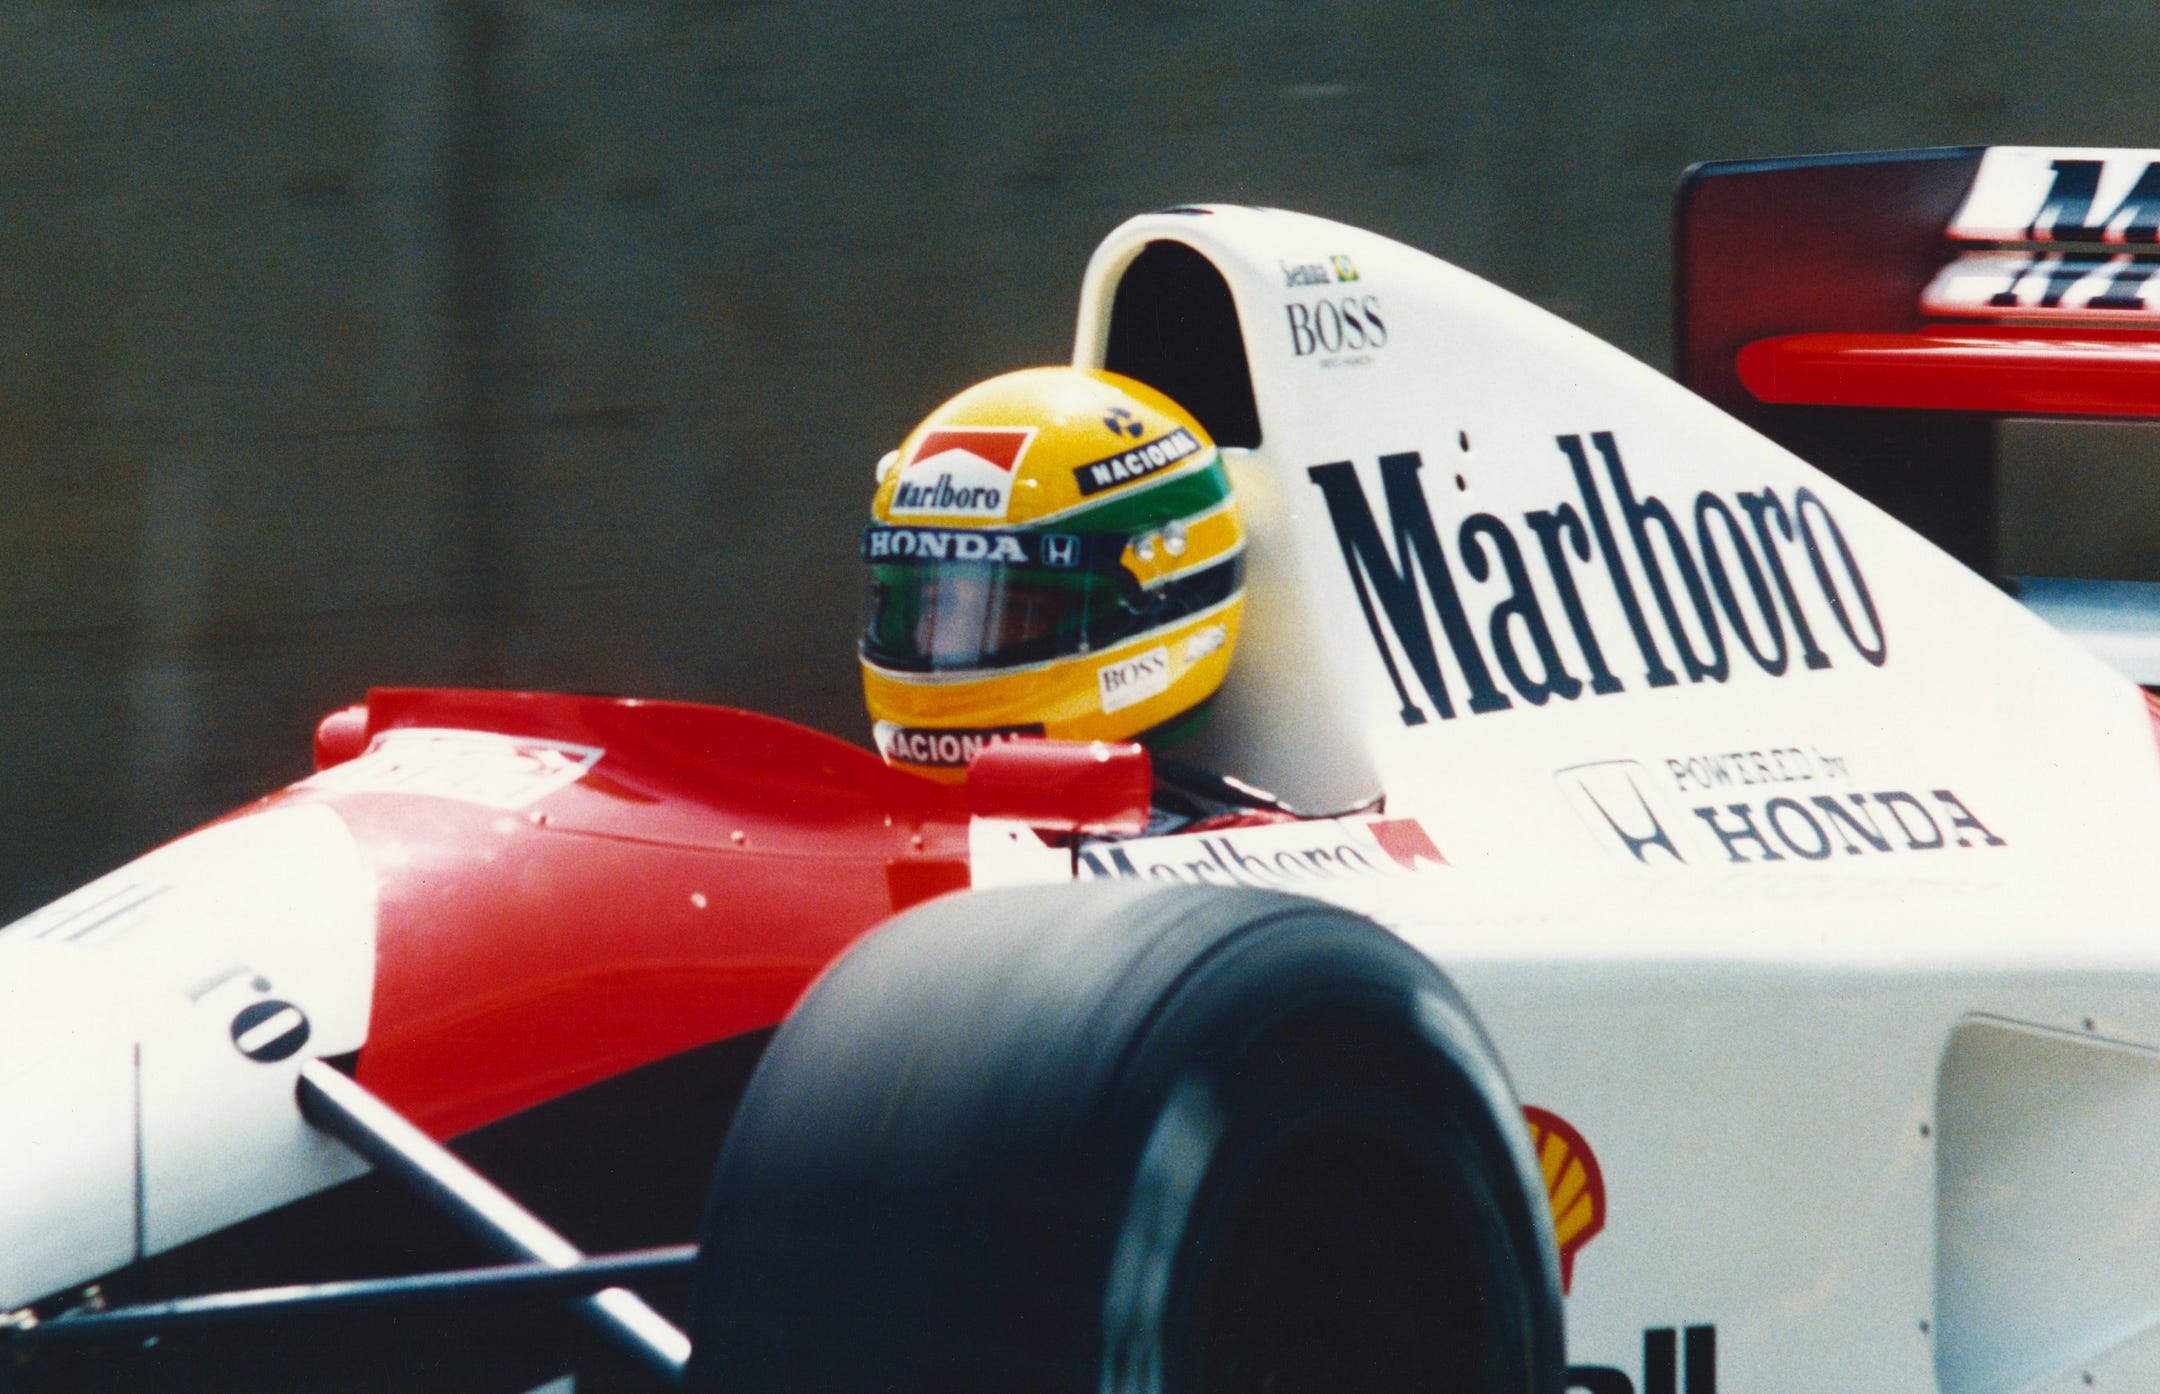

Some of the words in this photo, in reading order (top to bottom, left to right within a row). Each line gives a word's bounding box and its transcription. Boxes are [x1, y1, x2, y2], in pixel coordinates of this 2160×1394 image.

[1285, 294, 1388, 356] BOSS
[1090, 431, 1198, 487] NACIONAL
[894, 473, 1001, 510] Marlboro
[869, 530, 1028, 562] HONDA
[1307, 430, 1887, 727] Marlboro
[1102, 655, 1166, 693] BOSS
[1665, 747, 1814, 791] POWERED
[1692, 788, 2008, 864] HONDA
